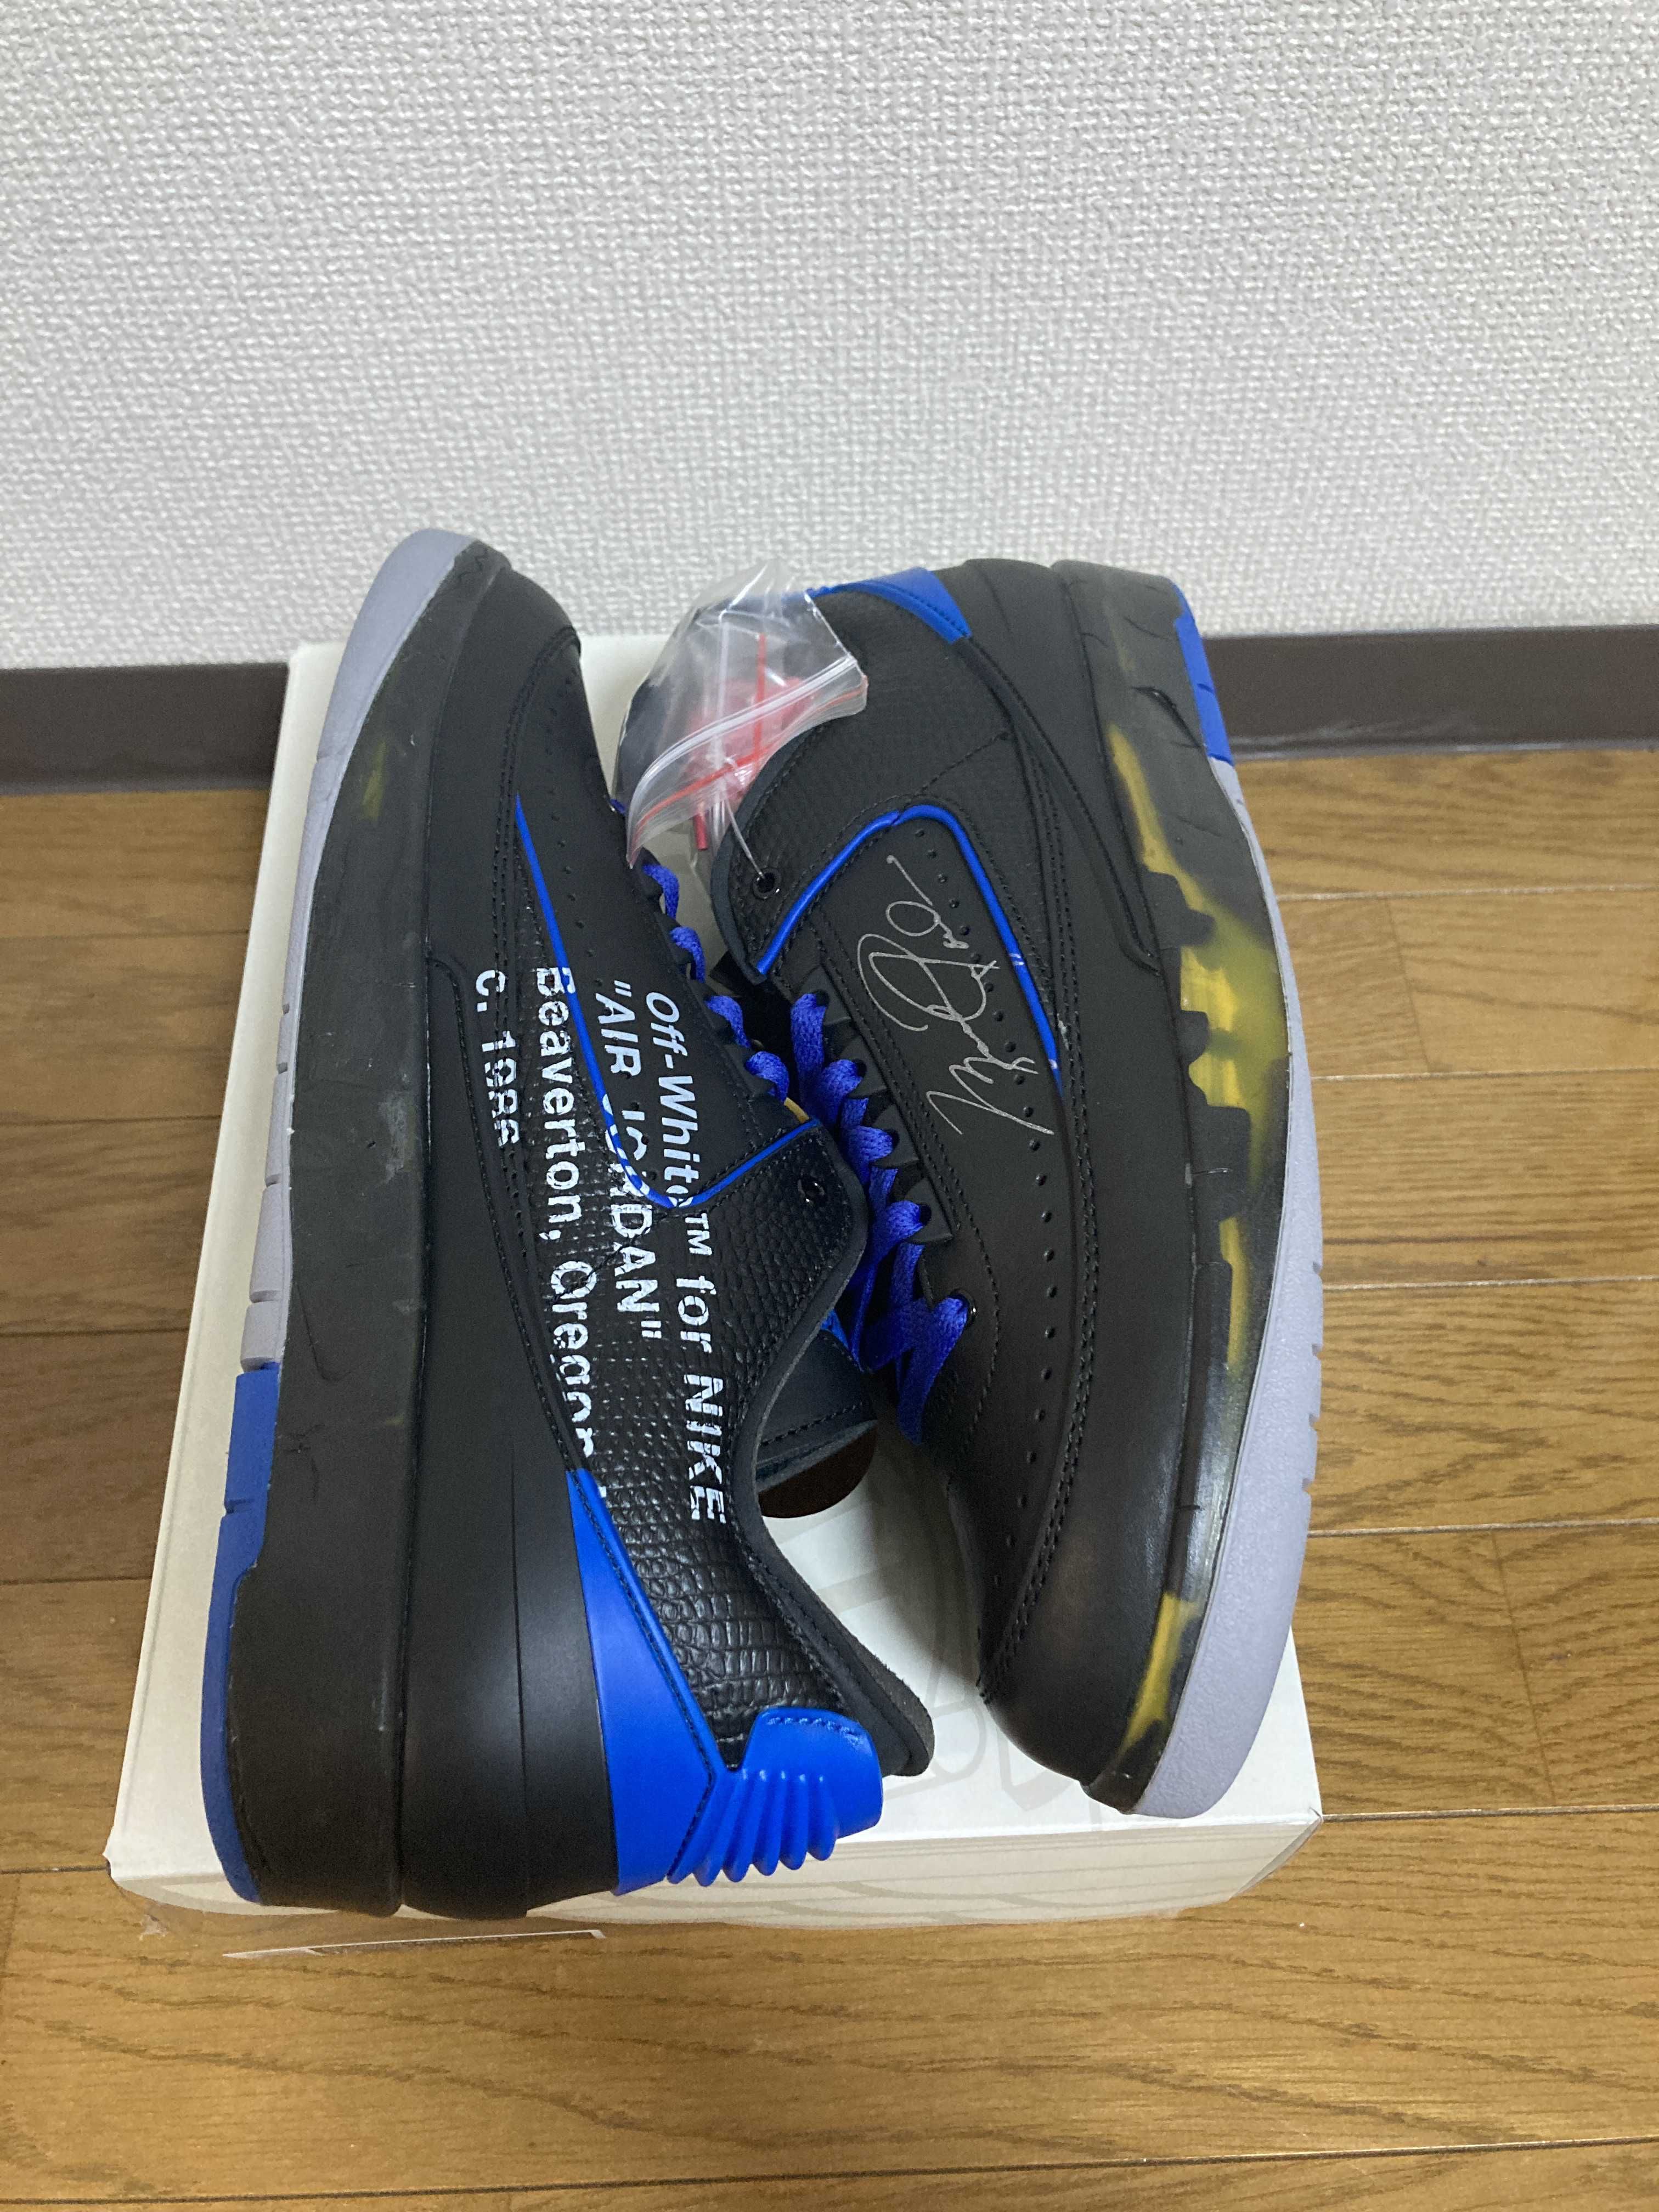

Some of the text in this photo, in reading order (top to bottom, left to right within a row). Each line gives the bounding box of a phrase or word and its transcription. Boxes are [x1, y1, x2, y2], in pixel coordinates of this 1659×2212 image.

[595, 980, 642, 1077] "AIR
[536, 967, 585, 1241] Beaverton,
[676, 1274, 716, 1353] for
[684, 1373, 727, 1524] NIKE
